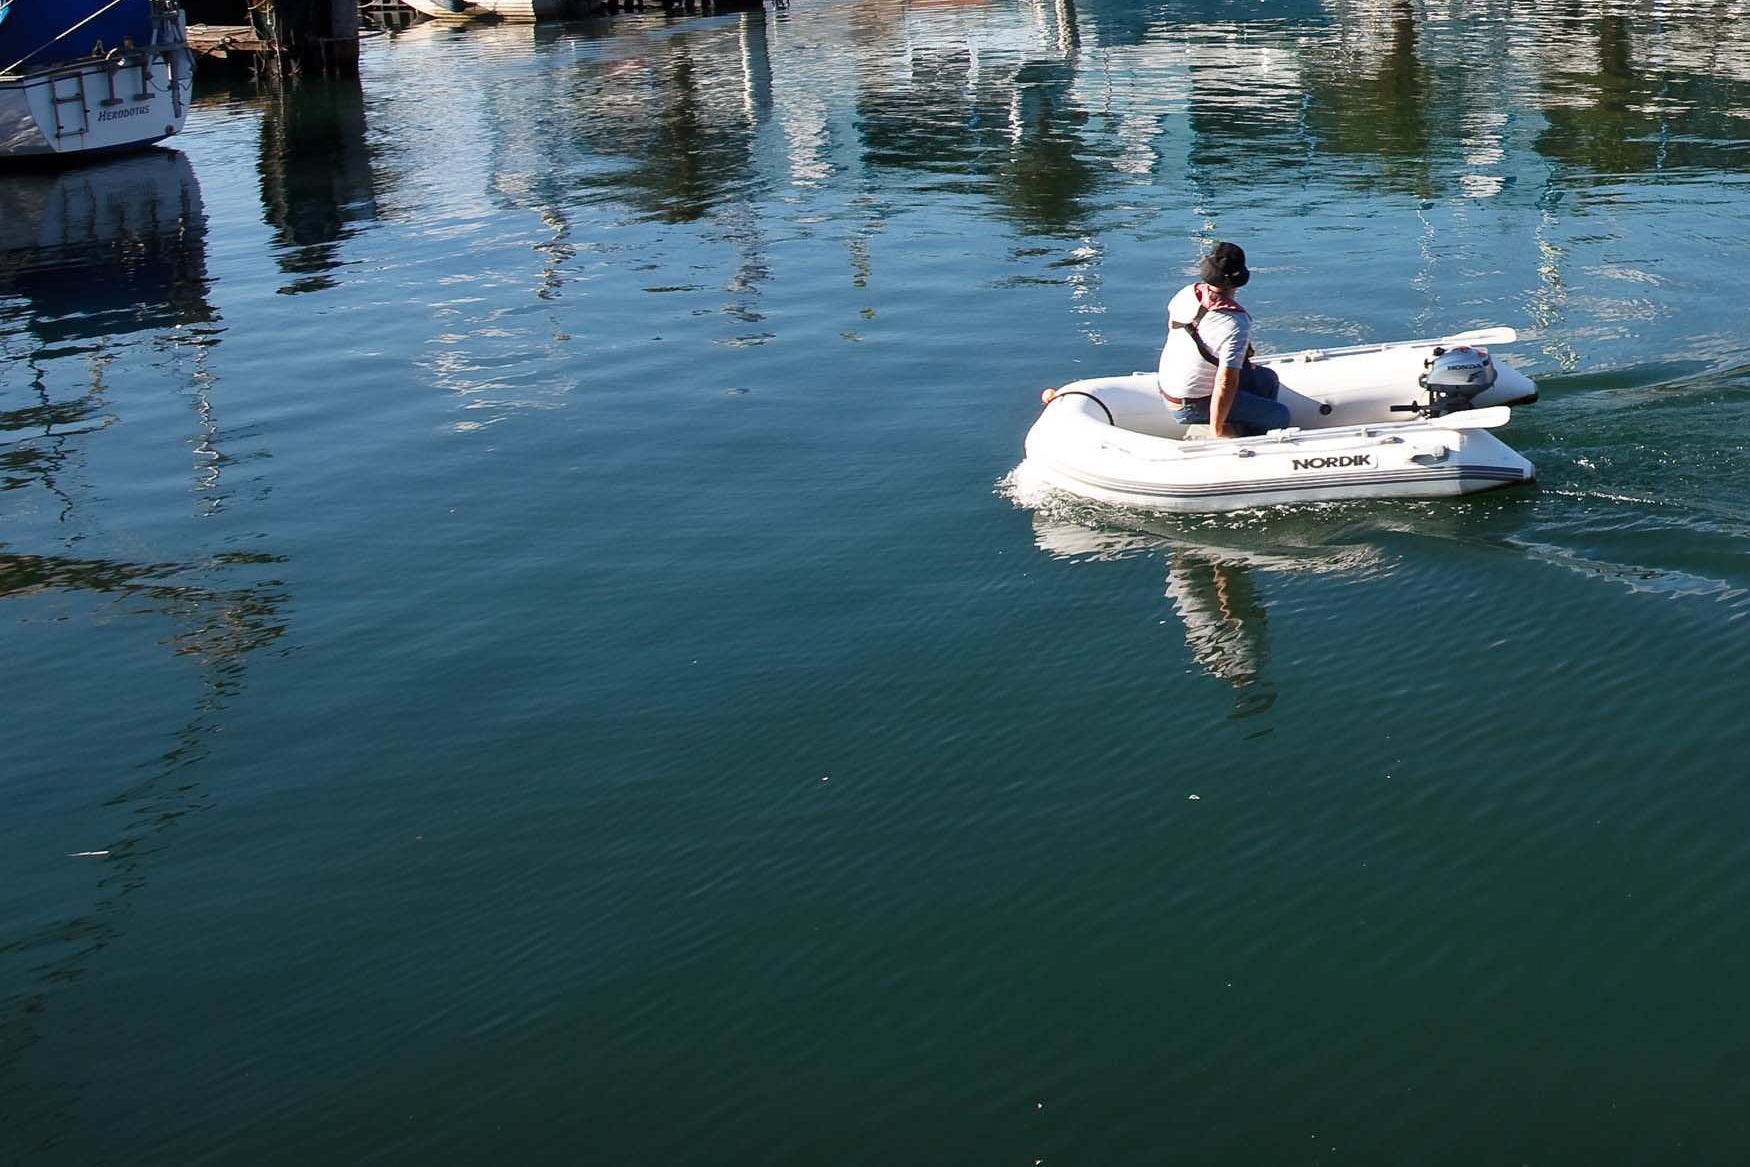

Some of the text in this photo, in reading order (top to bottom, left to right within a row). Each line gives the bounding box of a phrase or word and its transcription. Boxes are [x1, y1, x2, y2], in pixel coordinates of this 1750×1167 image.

[98, 105, 150, 122] HERODOTUS
[1447, 363, 1483, 371] HONDA
[1292, 454, 1371, 471] NORDIK
